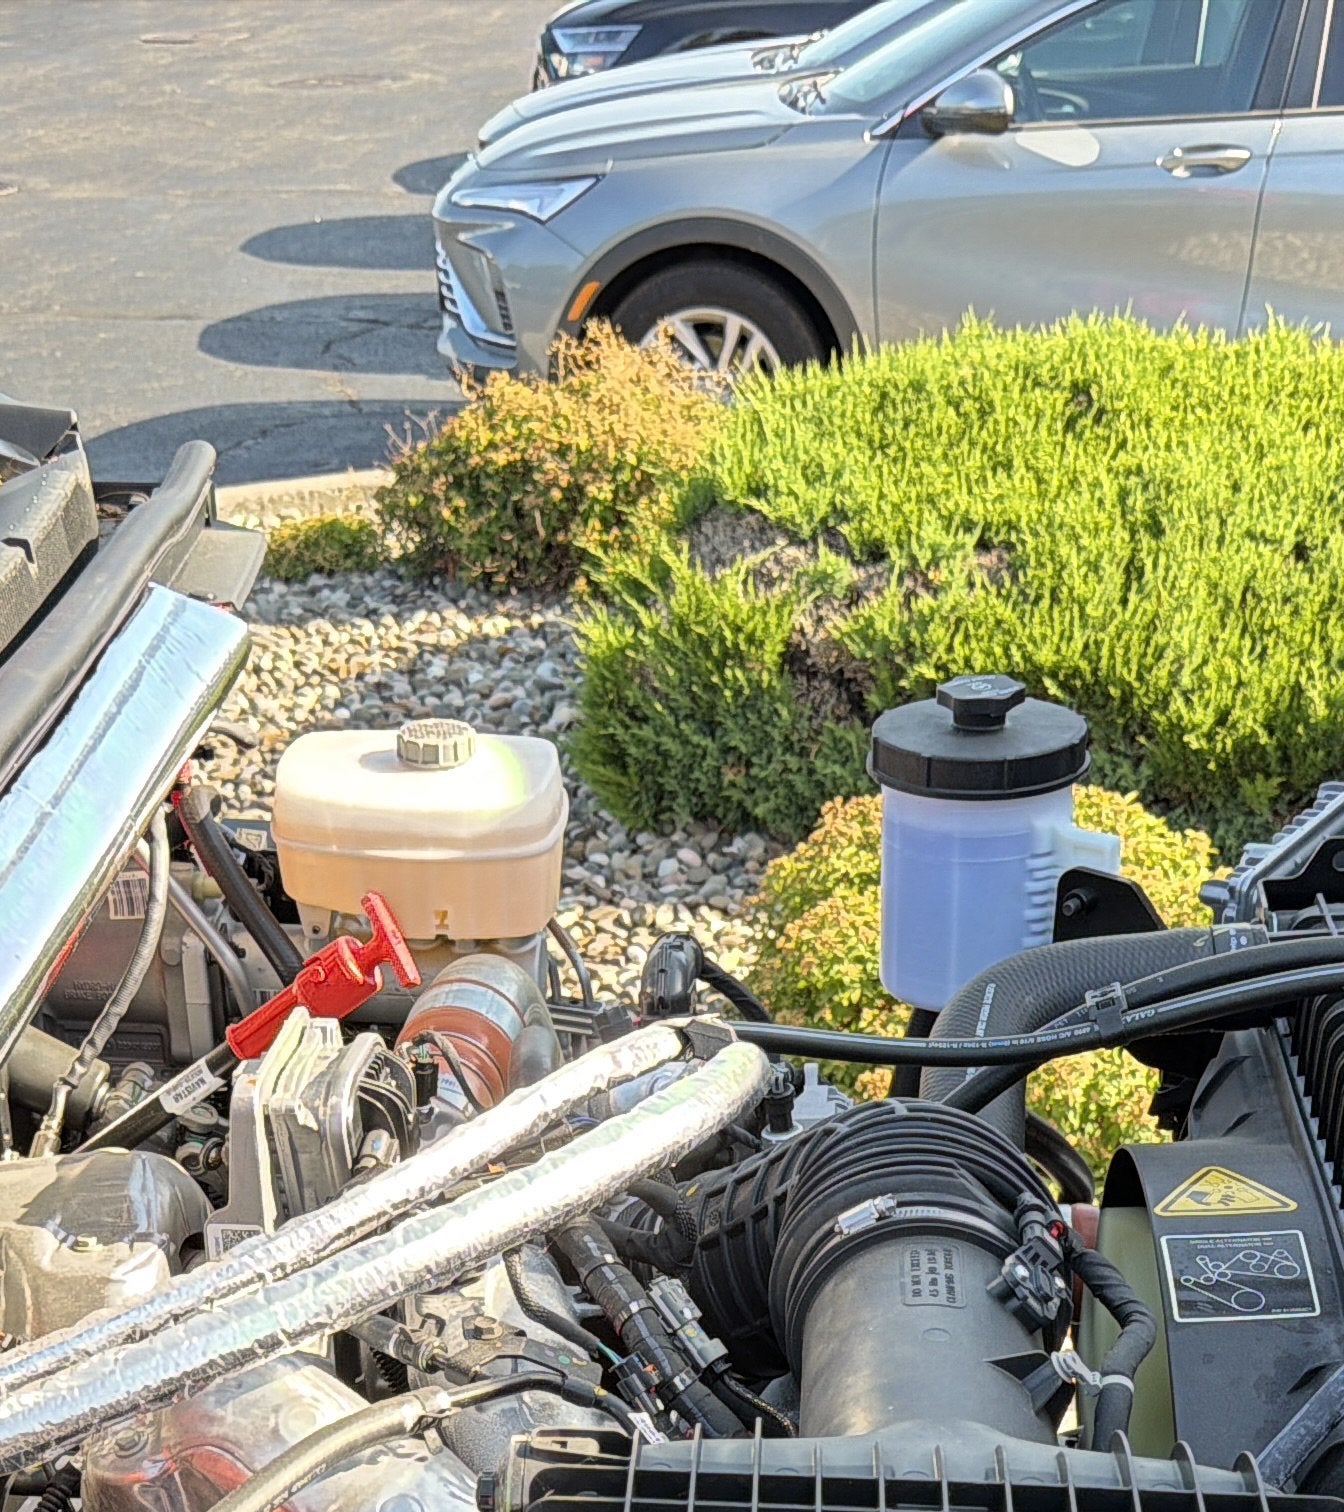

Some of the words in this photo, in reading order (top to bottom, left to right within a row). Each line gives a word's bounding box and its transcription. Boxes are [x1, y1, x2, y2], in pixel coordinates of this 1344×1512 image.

[1122, 1008, 1156, 1024] GALA
[1036, 1035, 1058, 1043] HOSE
[172, 1076, 207, 1103] NAVISTAR
